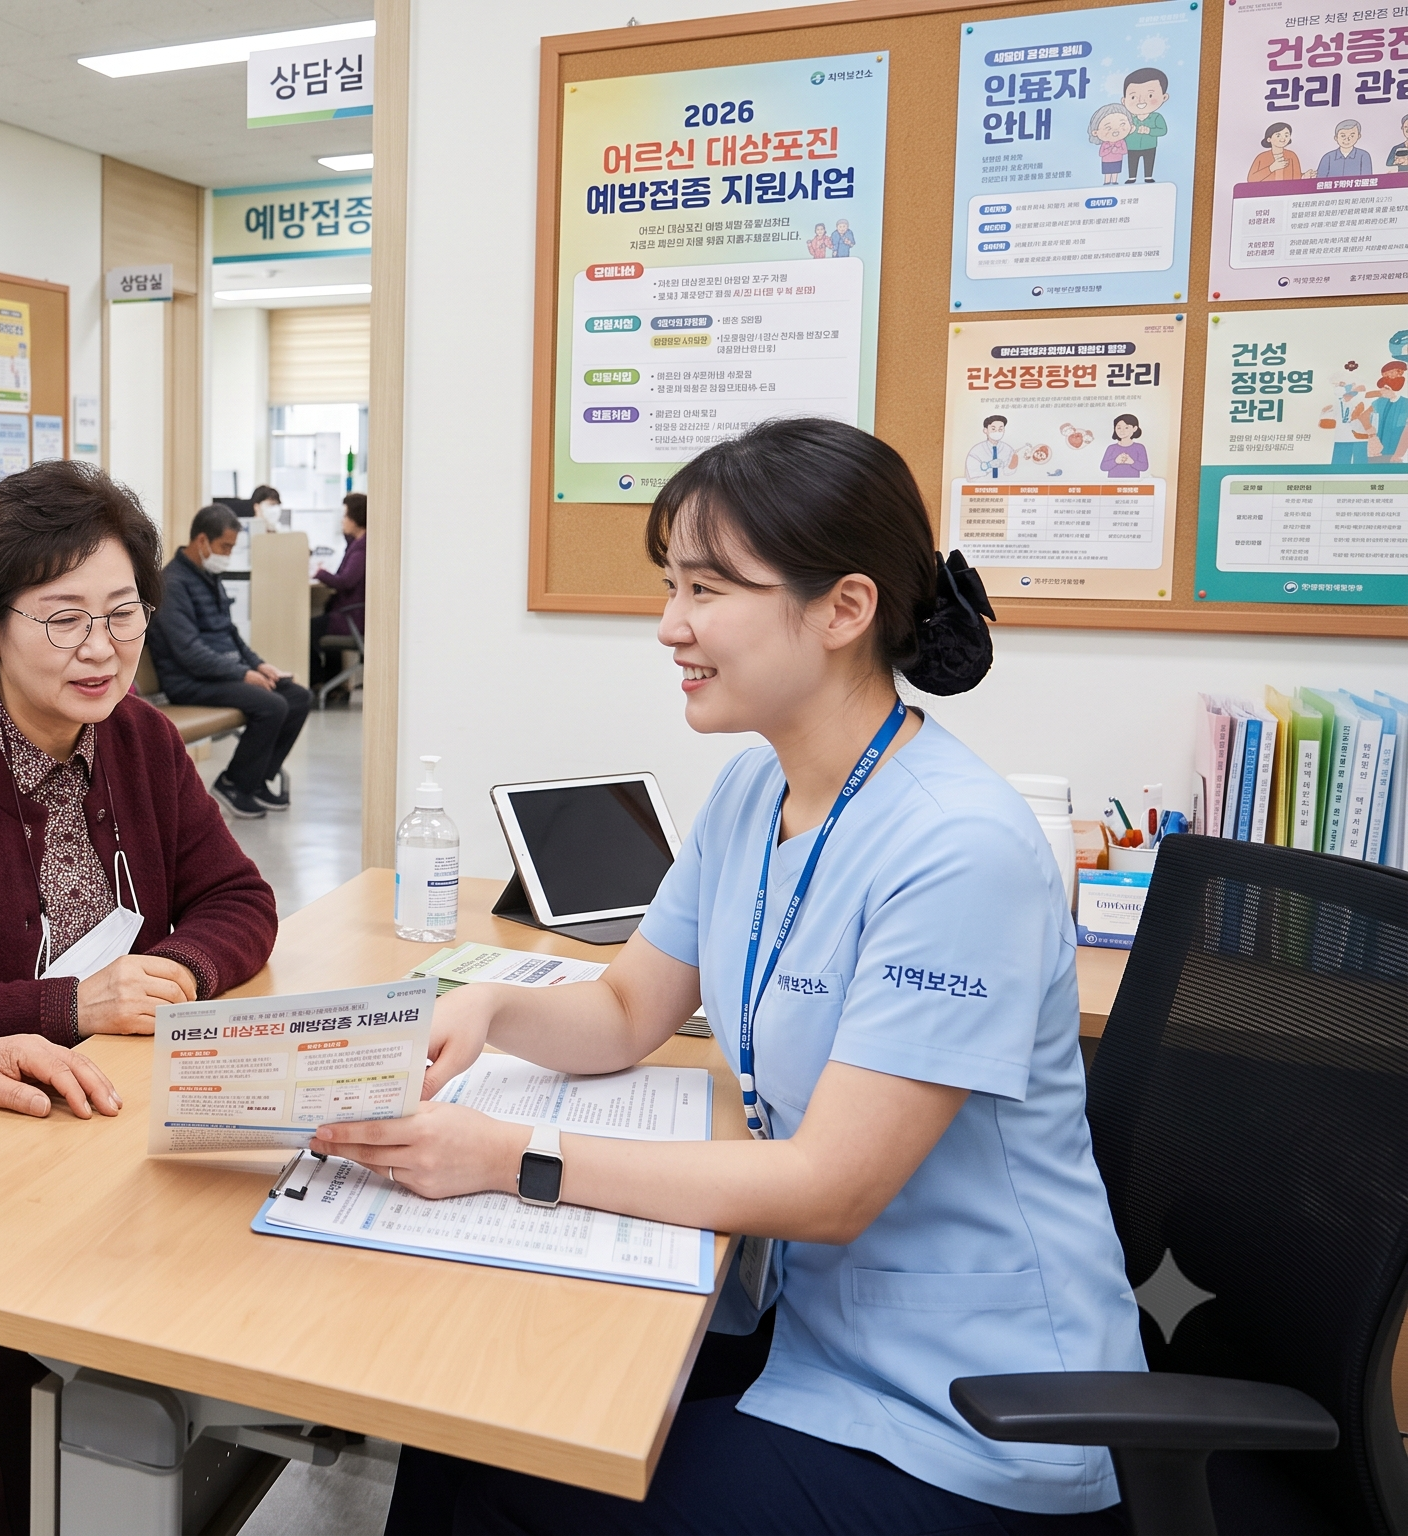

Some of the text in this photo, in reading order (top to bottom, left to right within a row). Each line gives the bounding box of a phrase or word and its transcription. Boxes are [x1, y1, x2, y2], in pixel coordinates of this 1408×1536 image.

[270, 54, 363, 100] 상담실
[1264, 73, 1341, 112] 관리
[684, 100, 754, 128] 2026
[983, 107, 1052, 144] 안내
[603, 127, 838, 175] 어르신 대상포진
[586, 167, 855, 215] 예방접종 지원사업
[245, 195, 373, 241] 예방접종
[120, 273, 162, 292] 상담실
[1232, 342, 1287, 367] 건성
[1106, 362, 1161, 387] 관리
[1231, 370, 1314, 395] 정항영
[1229, 398, 1284, 424] 관리
[882, 964, 988, 998] 지역보건소
[171, 1027, 218, 1041] 어르신
[222, 1022, 285, 1038] 대상포진
